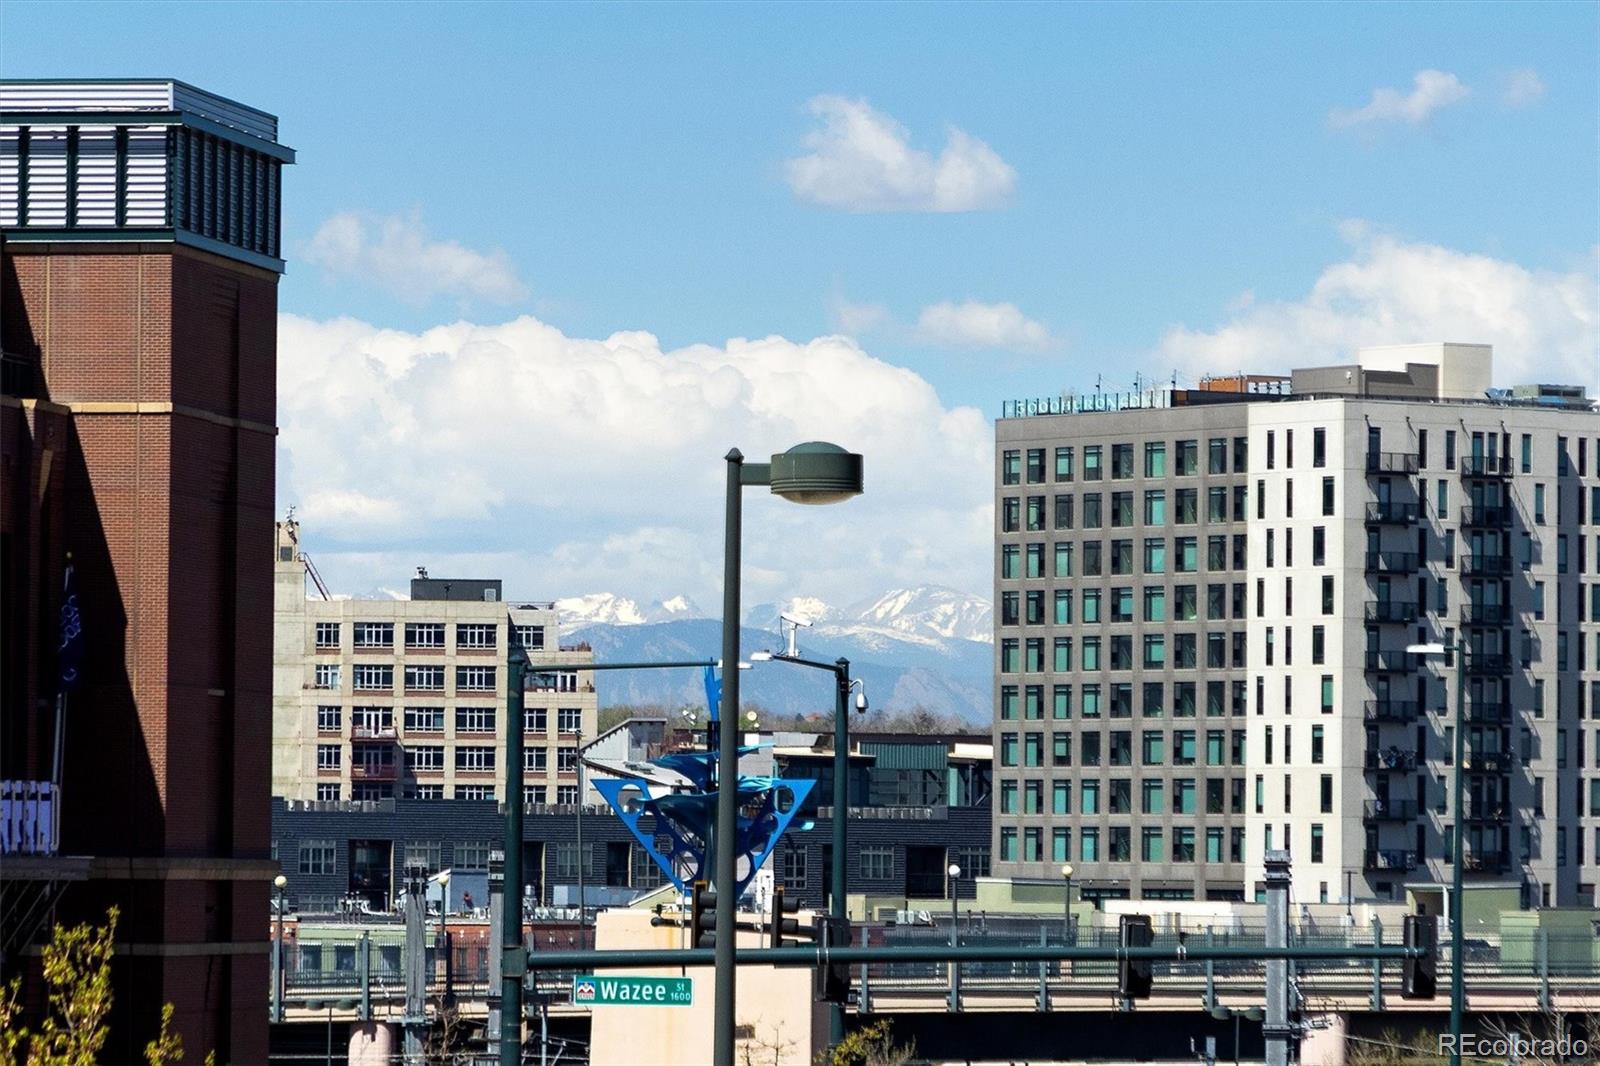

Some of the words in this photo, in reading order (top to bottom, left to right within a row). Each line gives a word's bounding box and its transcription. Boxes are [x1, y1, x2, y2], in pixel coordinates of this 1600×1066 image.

[601, 981, 667, 1001] Wazee
[676, 983, 685, 992] St
[671, 992, 691, 1001] 1600
